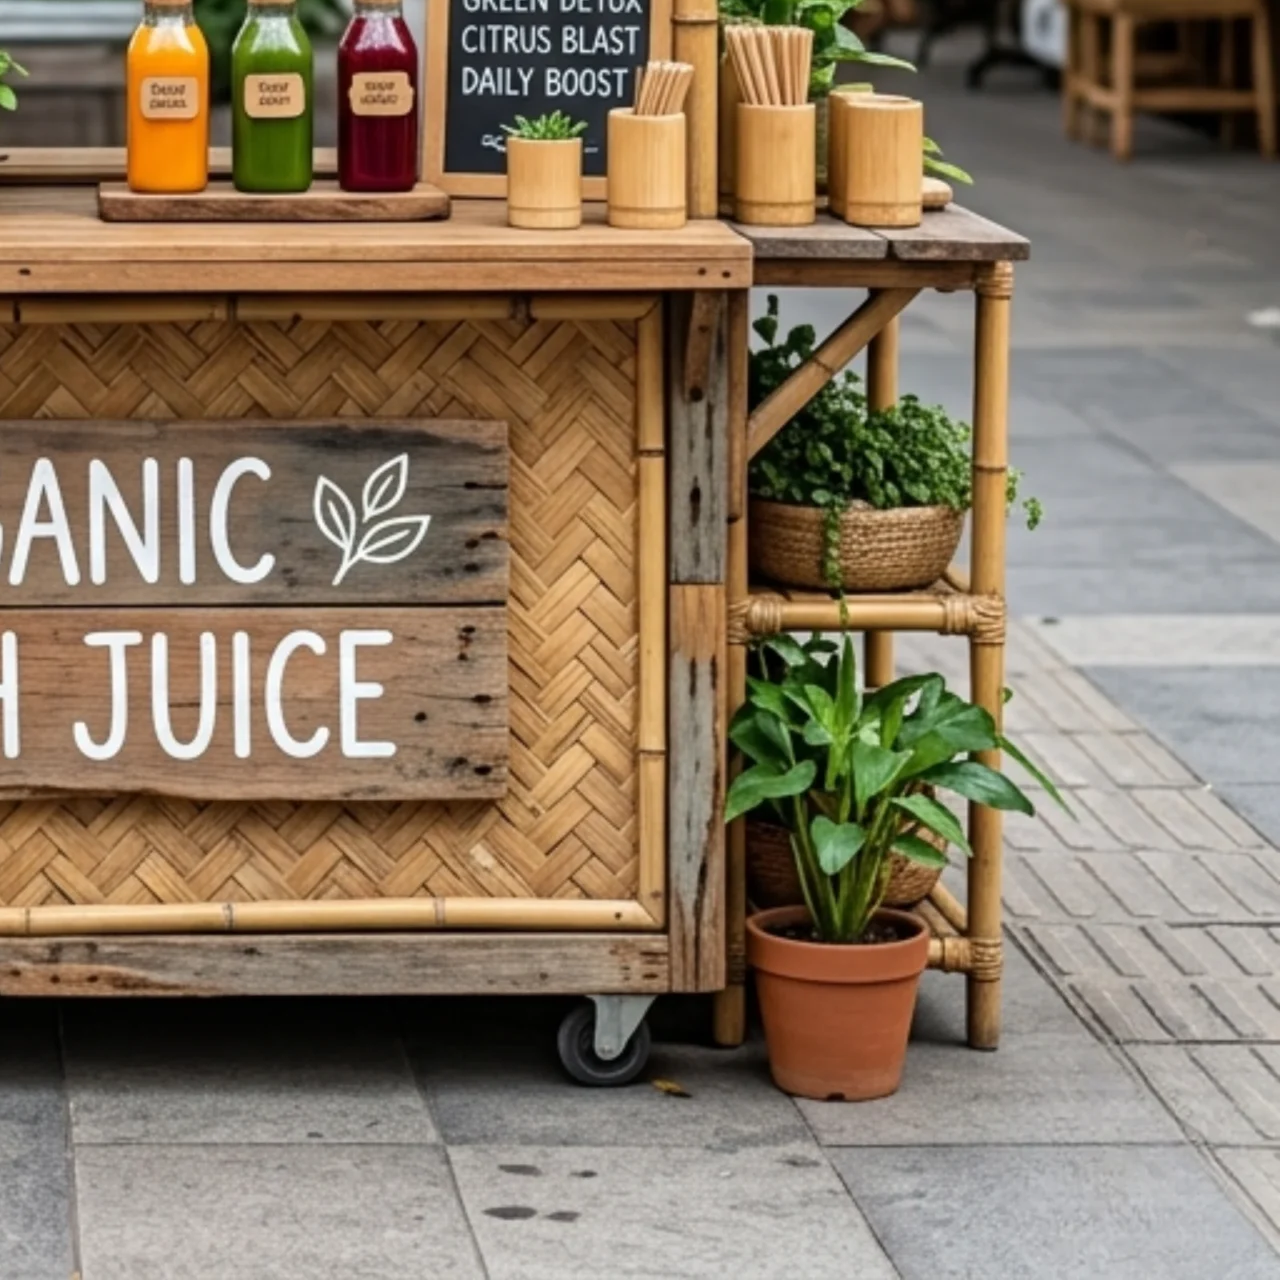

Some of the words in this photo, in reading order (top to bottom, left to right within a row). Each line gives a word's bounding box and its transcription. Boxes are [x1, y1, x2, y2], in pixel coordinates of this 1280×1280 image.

[461, 24, 552, 55] CITRUS
[561, 25, 641, 56] BLAST
[462, 66, 534, 96] DAILY
[545, 67, 629, 98] BOOST
[72, 629, 398, 762] JUICE
